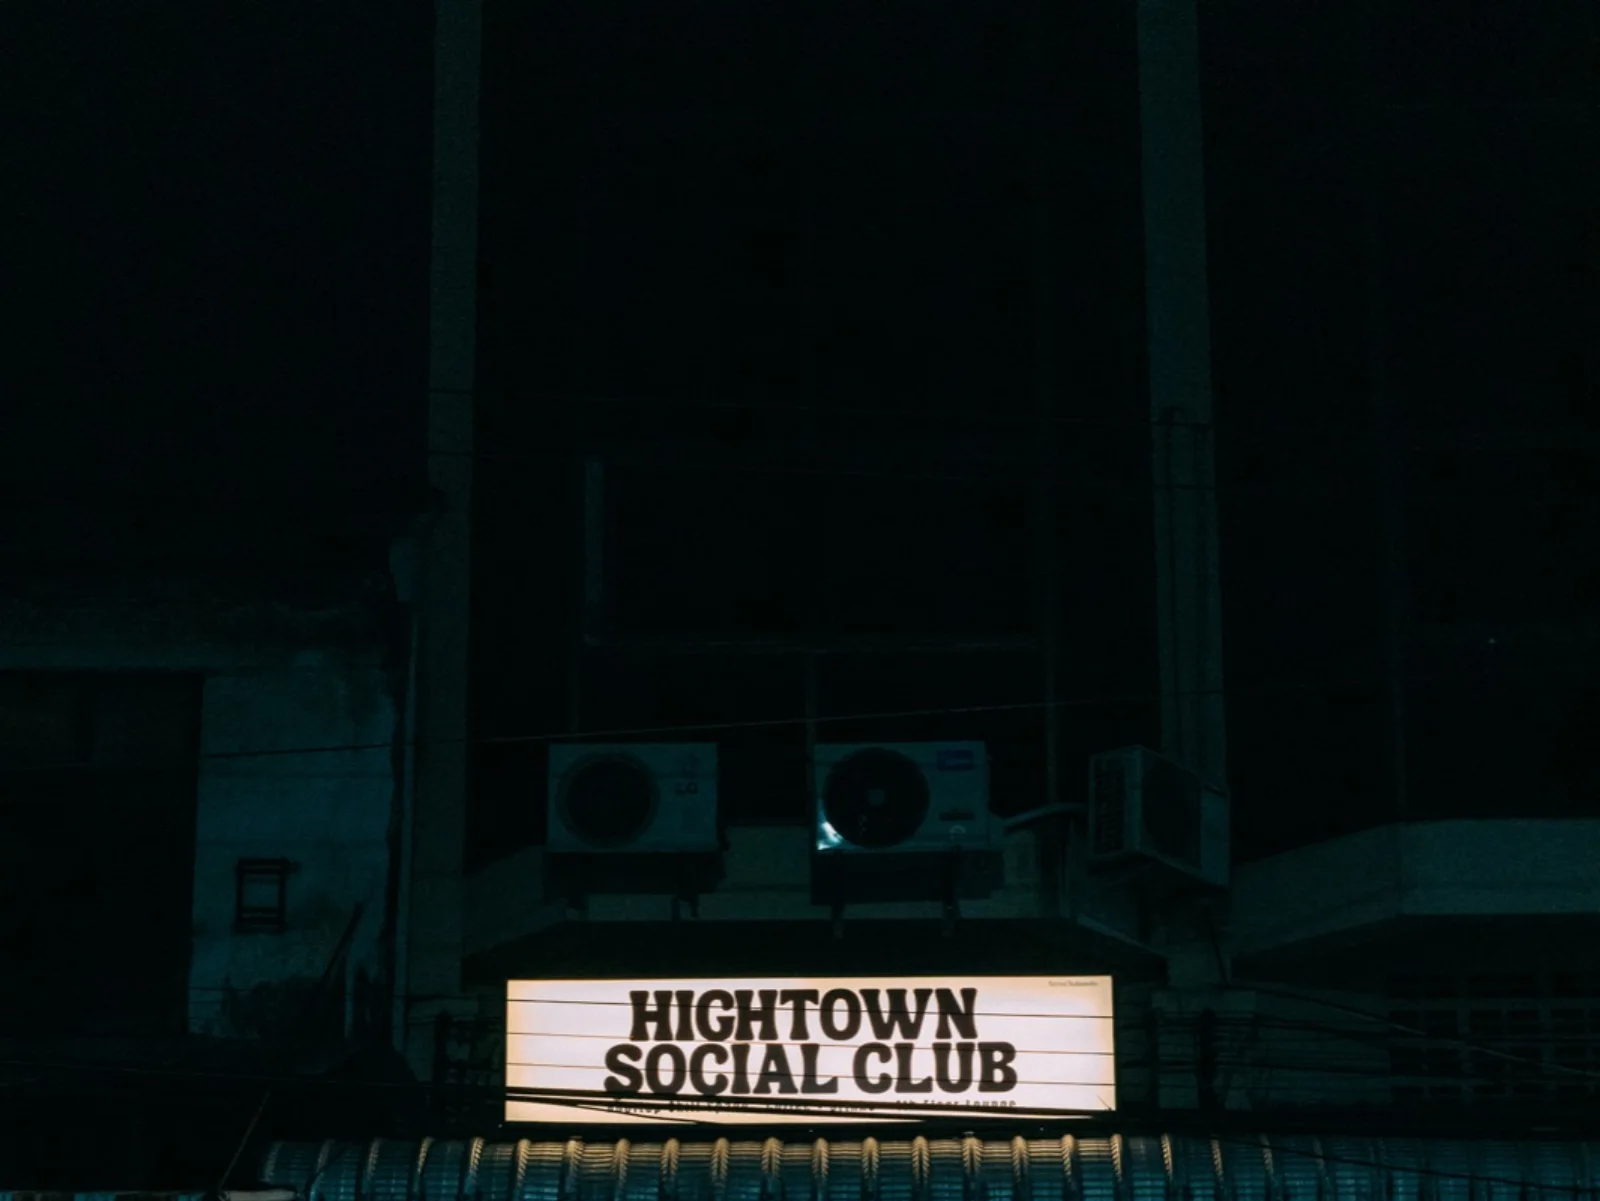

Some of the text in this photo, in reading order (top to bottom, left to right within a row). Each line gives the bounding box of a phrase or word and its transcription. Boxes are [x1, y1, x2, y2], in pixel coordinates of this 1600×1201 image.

[629, 988, 978, 1041] HIGHTOWN
[604, 1041, 1018, 1097] SOCIAL CLUB
